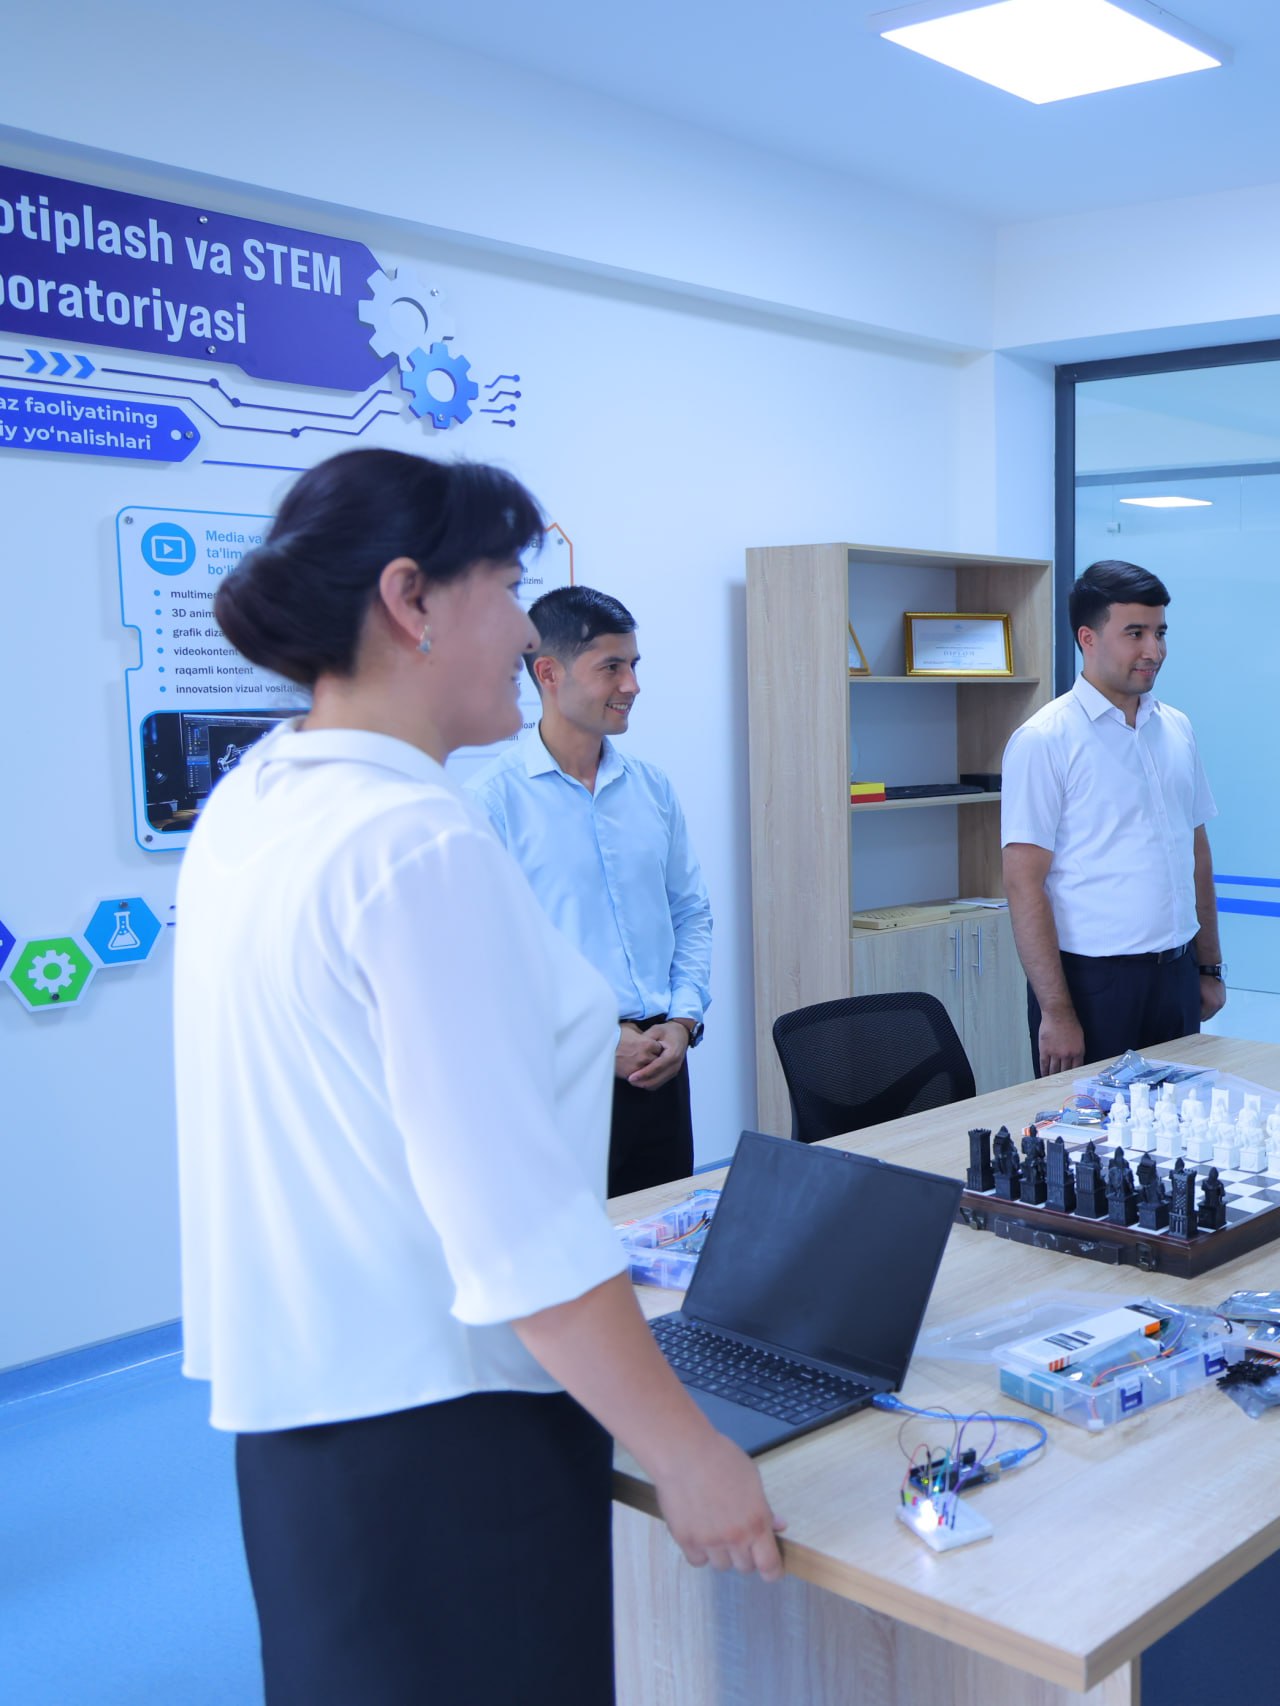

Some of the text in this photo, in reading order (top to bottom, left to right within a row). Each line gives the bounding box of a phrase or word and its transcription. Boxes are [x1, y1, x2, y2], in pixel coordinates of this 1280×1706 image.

[185, 237, 232, 276] va
[242, 239, 342, 296] STEM
[25, 397, 158, 428] faoliyatining
[206, 530, 262, 544] Media va
[172, 609, 186, 618] 3D
[173, 628, 202, 638] grafik
[175, 666, 253, 676] raqamli kontent
[176, 685, 233, 694] innovatsion
[236, 684, 263, 693] vizual
